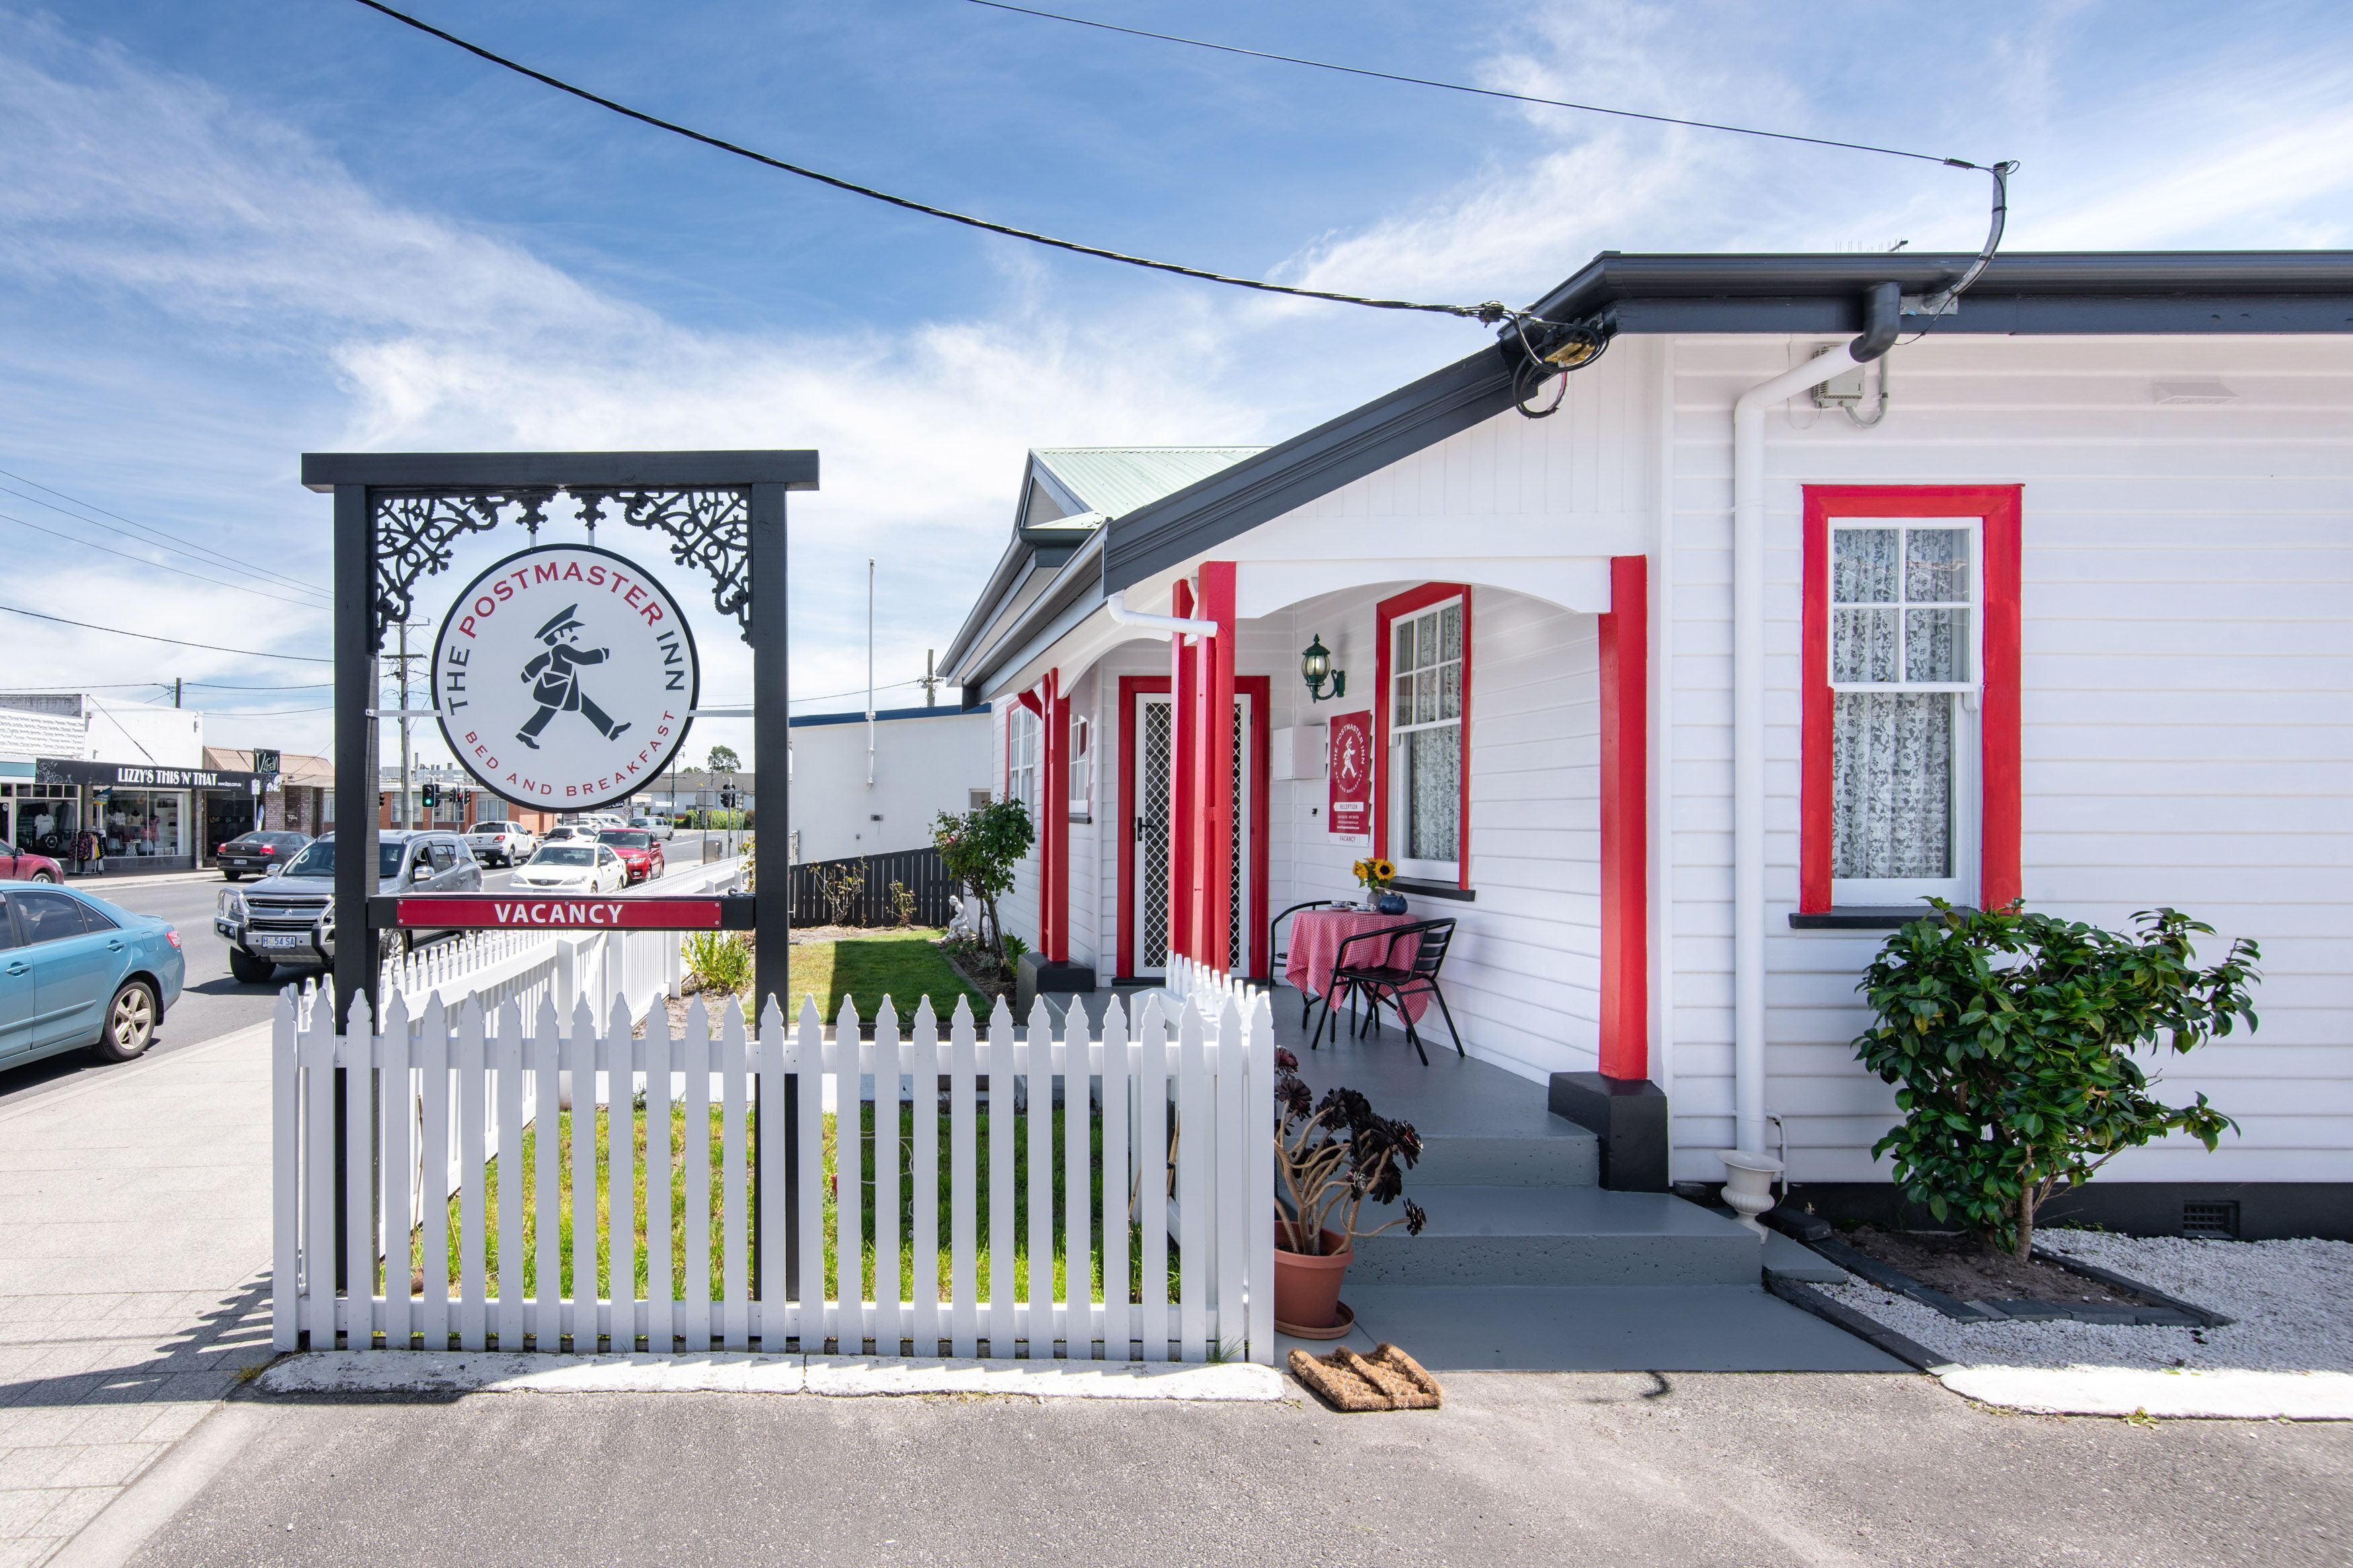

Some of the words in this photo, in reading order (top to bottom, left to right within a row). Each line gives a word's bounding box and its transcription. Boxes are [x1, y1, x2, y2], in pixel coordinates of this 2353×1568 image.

[458, 561, 664, 639] POSTMASTER
[447, 646, 470, 716] THE
[656, 630, 684, 691] INN
[465, 731, 499, 770] BED
[506, 772, 552, 796] AND
[566, 710, 675, 797] BREAKFAST
[1337, 723, 1363, 745] POSTMASTER
[118, 768, 153, 783] LIZZY'S
[156, 770, 180, 784] THIS
[181, 772, 191, 785] 'N'
[193, 772, 217, 786] THAT
[495, 903, 623, 923] VACANCY
[286, 938, 294, 946] SA
